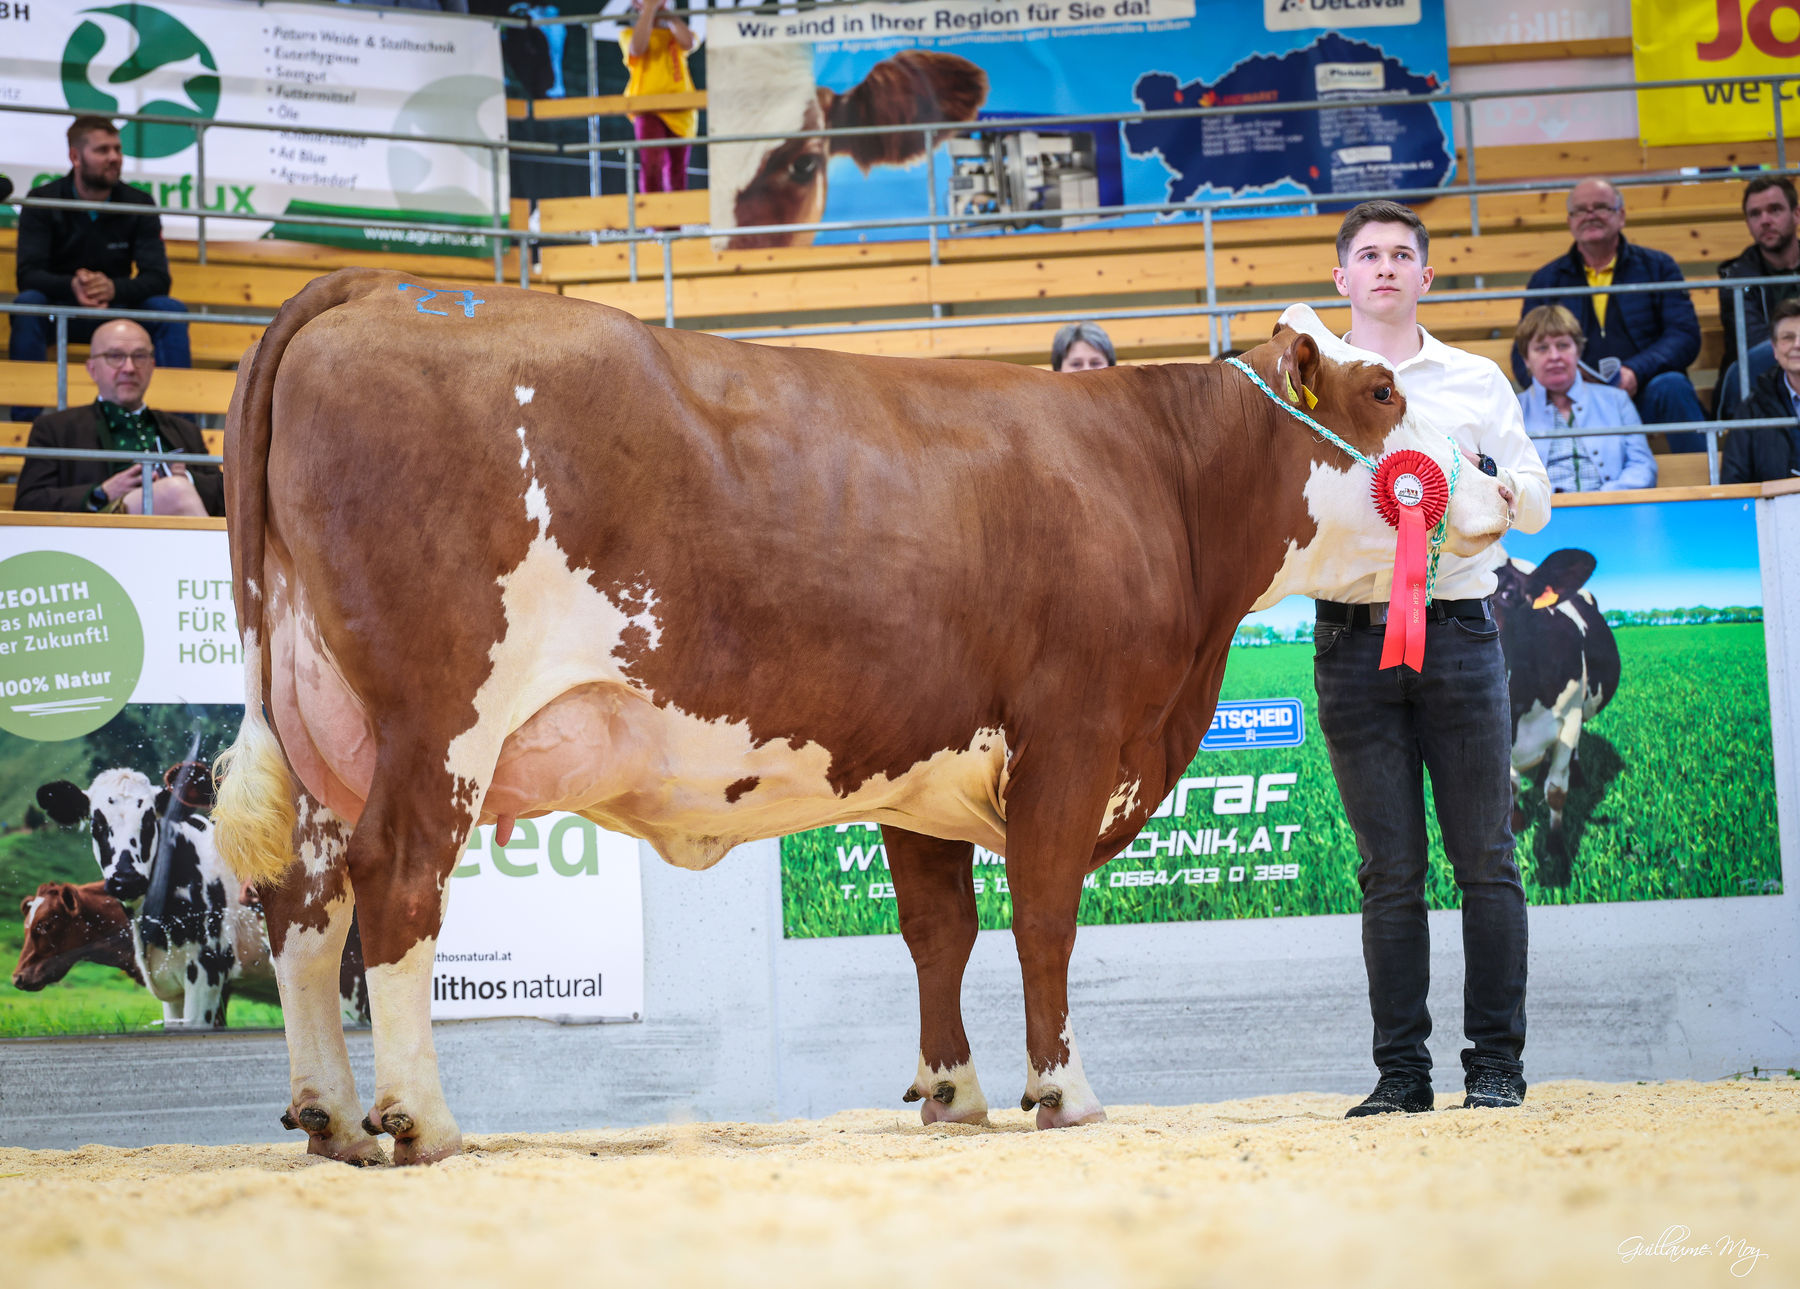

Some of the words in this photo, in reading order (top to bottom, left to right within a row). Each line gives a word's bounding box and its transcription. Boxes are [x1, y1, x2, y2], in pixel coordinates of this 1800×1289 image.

[738, 21, 777, 38] Wir
[786, 16, 834, 37] sind
[843, 15, 863, 33] in
[871, 13, 926, 31] Ihrer
[935, 7, 1019, 29] Region
[1027, 3, 1060, 22] für
[1068, 2, 1105, 21] Sie
[1114, 0, 1151, 16] da!
[320, 30, 359, 46] Weide
[365, 37, 375, 48] &
[380, 37, 456, 54] Stalltechnik
[274, 47, 360, 65] Euterhygiene
[276, 66, 326, 83] Saatgut
[276, 85, 357, 103] Futtermittel
[278, 148, 295, 161] Ad
[300, 151, 327, 165] Blue
[279, 169, 359, 189] Agrarbedarf
[0, 617, 21, 632] as
[28, 603, 103, 629] Mineral
[178, 606, 226, 632] FÜR
[0, 641, 18, 655] er
[24, 625, 109, 652] Zukunft!
[178, 638, 245, 664] HÖH
[0, 675, 49, 697] 100%
[54, 670, 112, 690] Natur
[1209, 707, 1293, 730] ETSCHEID
[1113, 825, 1301, 860] CHNIK.AT
[840, 884, 858, 900] T.
[1082, 874, 1100, 889] M.
[1109, 868, 1220, 888] 0664/133
[1228, 866, 1245, 882] 0
[1253, 864, 1300, 881] 399
